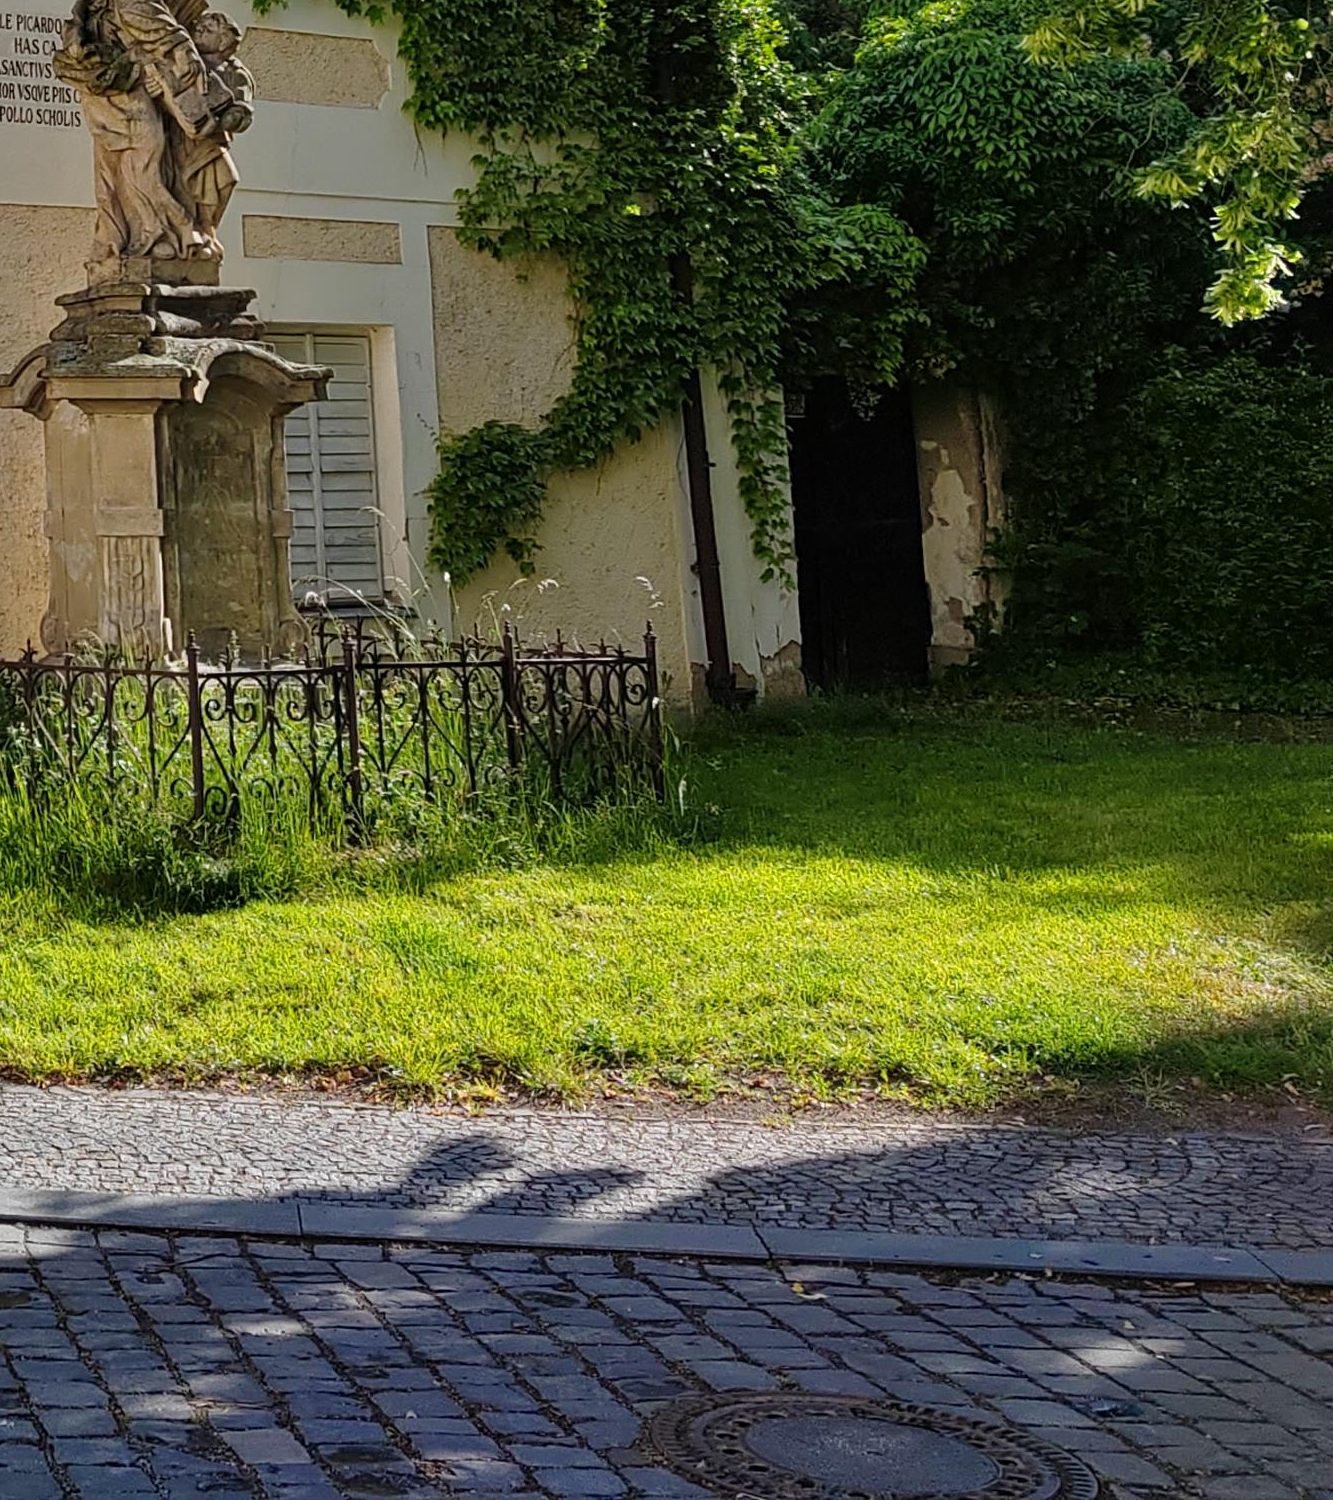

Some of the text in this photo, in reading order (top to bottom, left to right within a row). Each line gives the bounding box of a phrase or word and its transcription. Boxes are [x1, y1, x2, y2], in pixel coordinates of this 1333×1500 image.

[17, 14, 62, 35] PICARDO
[14, 37, 39, 55] HAS
[17, 83, 51, 103] VSQVE
[52, 86, 72, 104] PIIS
[36, 108, 81, 128] SCHOLIS
